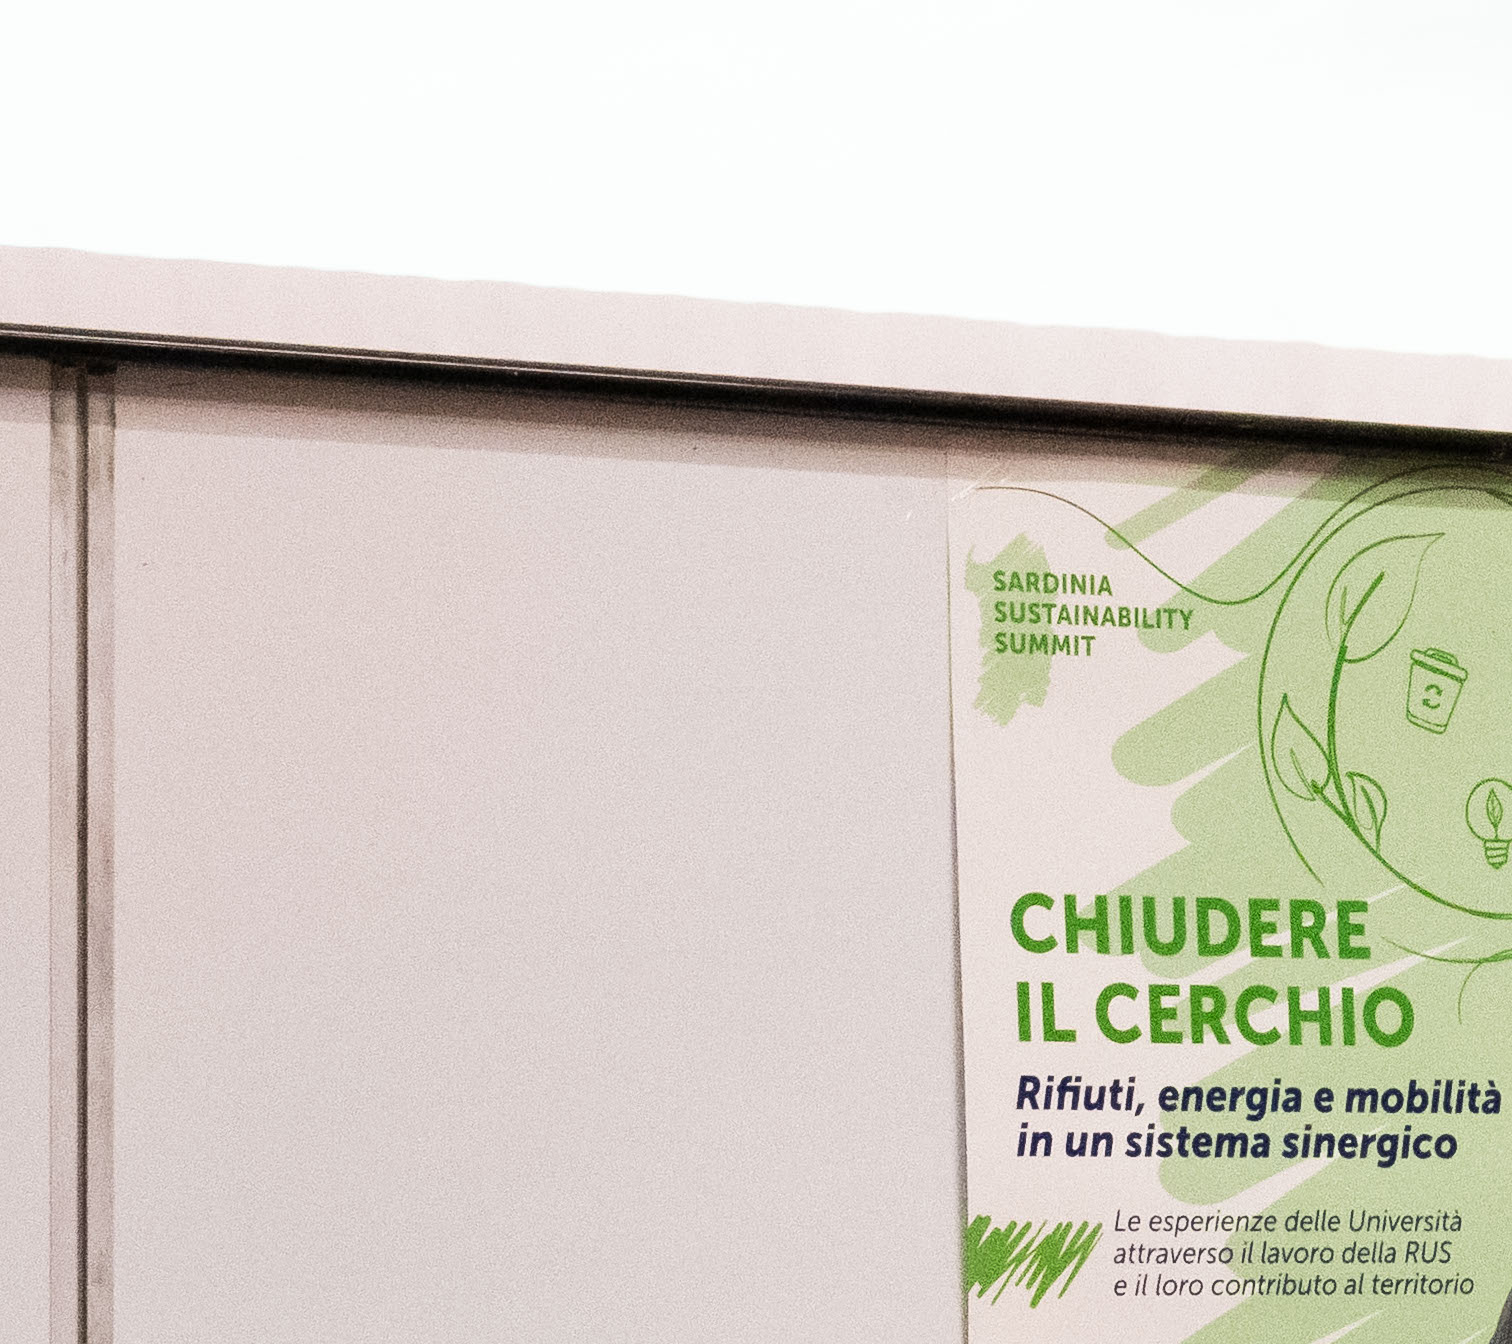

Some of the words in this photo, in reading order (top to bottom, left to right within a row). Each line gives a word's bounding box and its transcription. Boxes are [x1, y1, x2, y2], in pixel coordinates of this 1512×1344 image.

[993, 570, 1113, 596] SARDINIA
[994, 601, 1193, 630] SUSTAINABILITY
[995, 632, 1096, 656] SUMMIT
[1010, 891, 1372, 960] CHIUDERE
[1016, 981, 1077, 1043] IL
[1095, 982, 1415, 1048] CERCHIO
[1016, 1075, 1145, 1116] Rifiuti,
[1158, 1078, 1302, 1121] energia
[1314, 1087, 1334, 1113] e
[1345, 1079, 1502, 1114] mobilità
[1016, 1122, 1053, 1157] in
[1065, 1131, 1114, 1157] un
[1125, 1123, 1270, 1158] sistema
[1282, 1124, 1457, 1168] sinergico
[1114, 1209, 1141, 1232] Le
[1149, 1209, 1277, 1237] esperienze
[1284, 1209, 1340, 1232] delle
[1349, 1209, 1462, 1232] Università
[1113, 1243, 1233, 1264] attraverso
[1241, 1241, 1254, 1264] il
[1261, 1241, 1334, 1264] lavoro
[1342, 1241, 1397, 1264] della
[1405, 1241, 1452, 1264] RUS
[1114, 1279, 1127, 1296] e
[1135, 1273, 1148, 1296] il
[1155, 1273, 1203, 1296] loro
[1211, 1273, 1337, 1296] contributo
[1344, 1273, 1364, 1295] al
[1372, 1273, 1474, 1295] territorio
